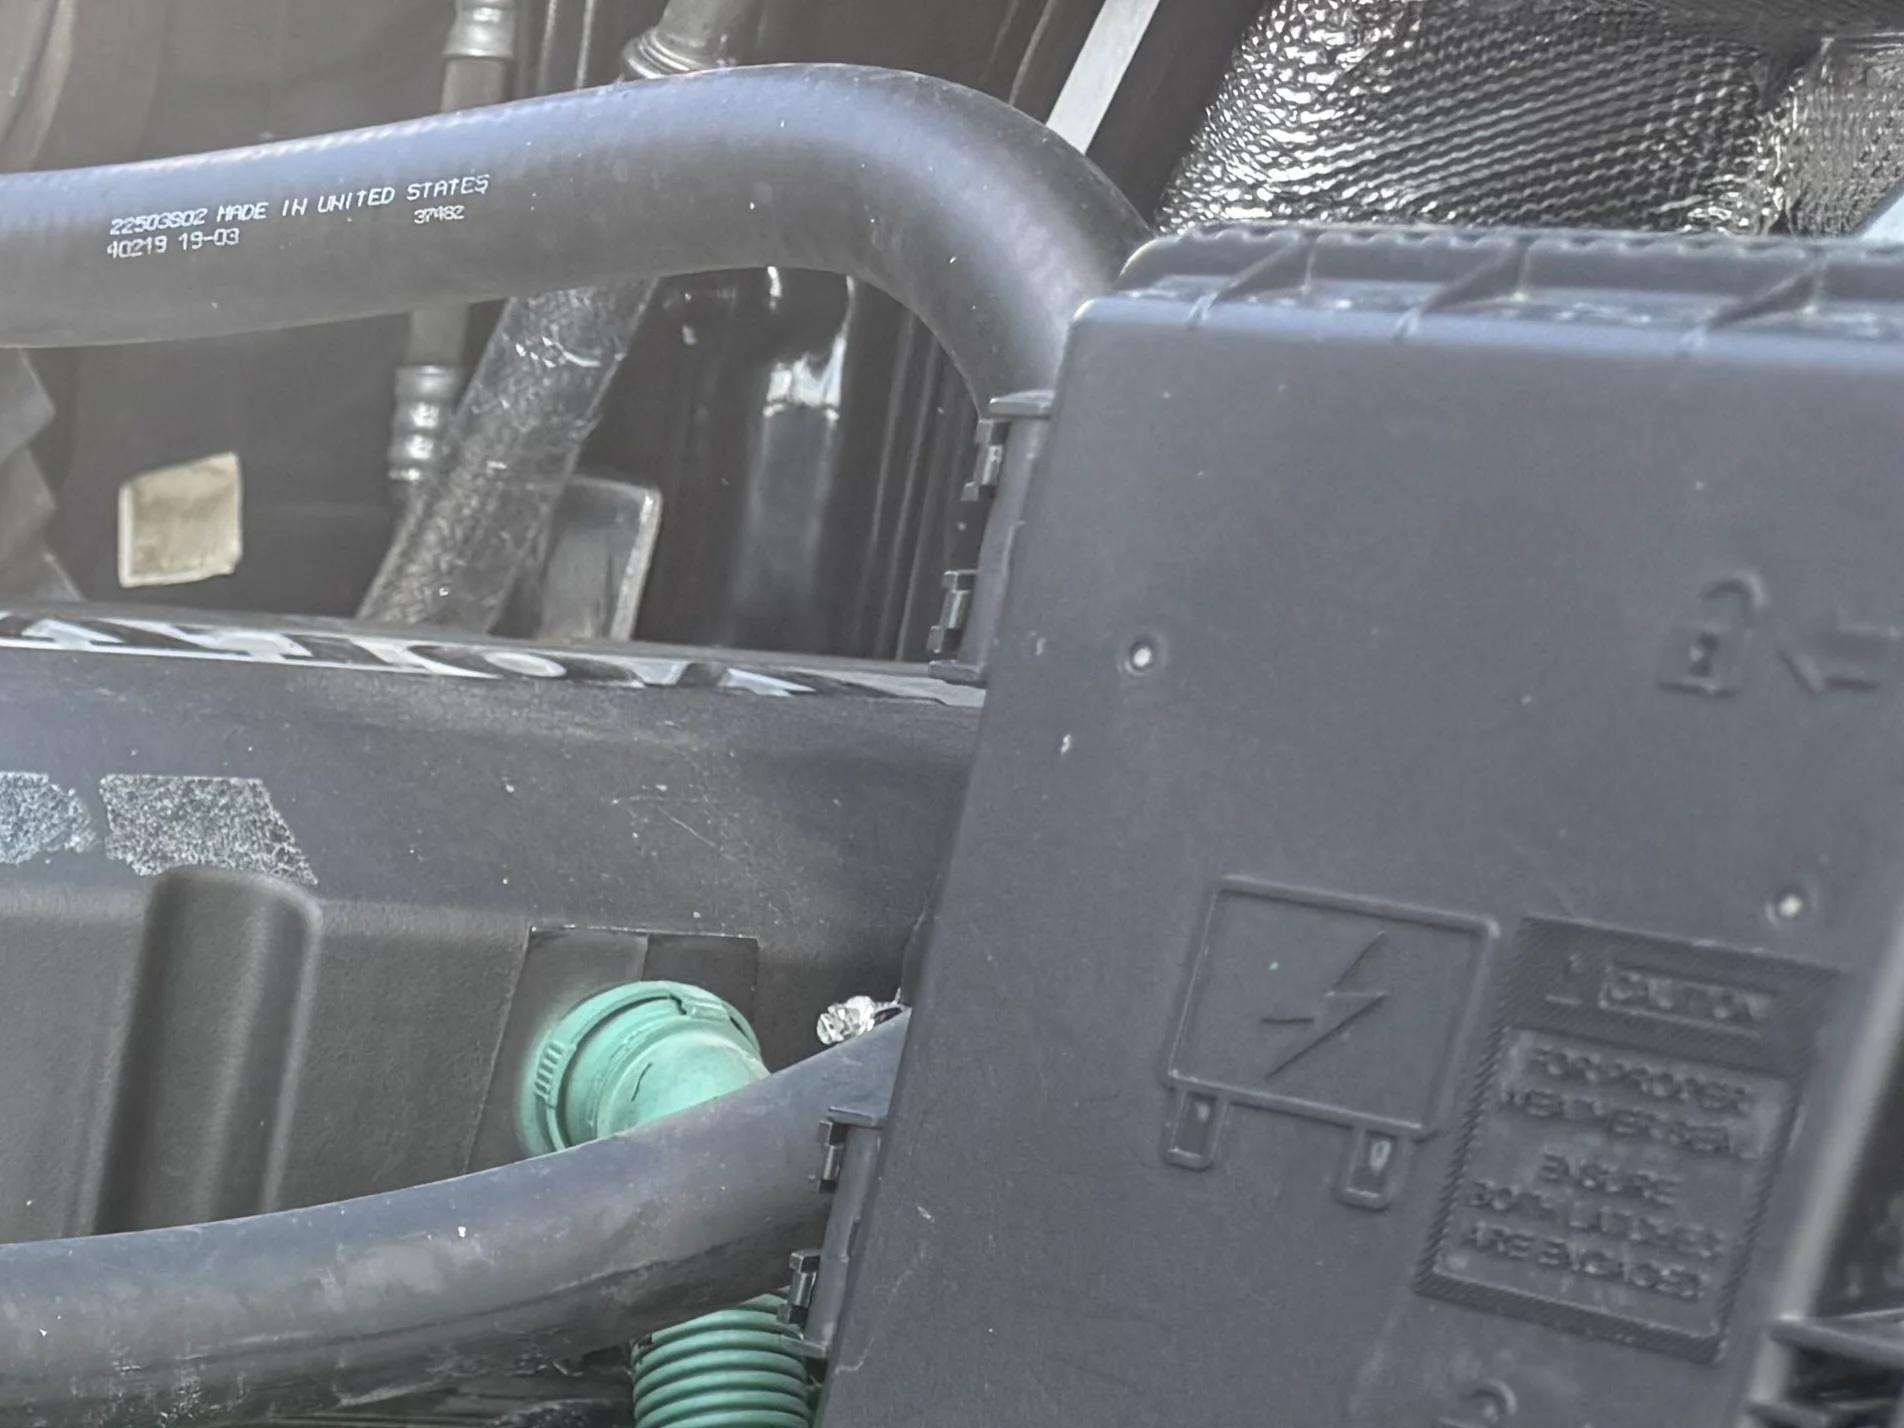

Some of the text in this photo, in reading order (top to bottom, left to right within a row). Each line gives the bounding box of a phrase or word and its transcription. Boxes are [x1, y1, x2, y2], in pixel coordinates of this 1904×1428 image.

[217, 203, 266, 223] MADE
[282, 198, 305, 216] IN
[317, 186, 394, 213] UNITED
[407, 174, 490, 200] STATES
